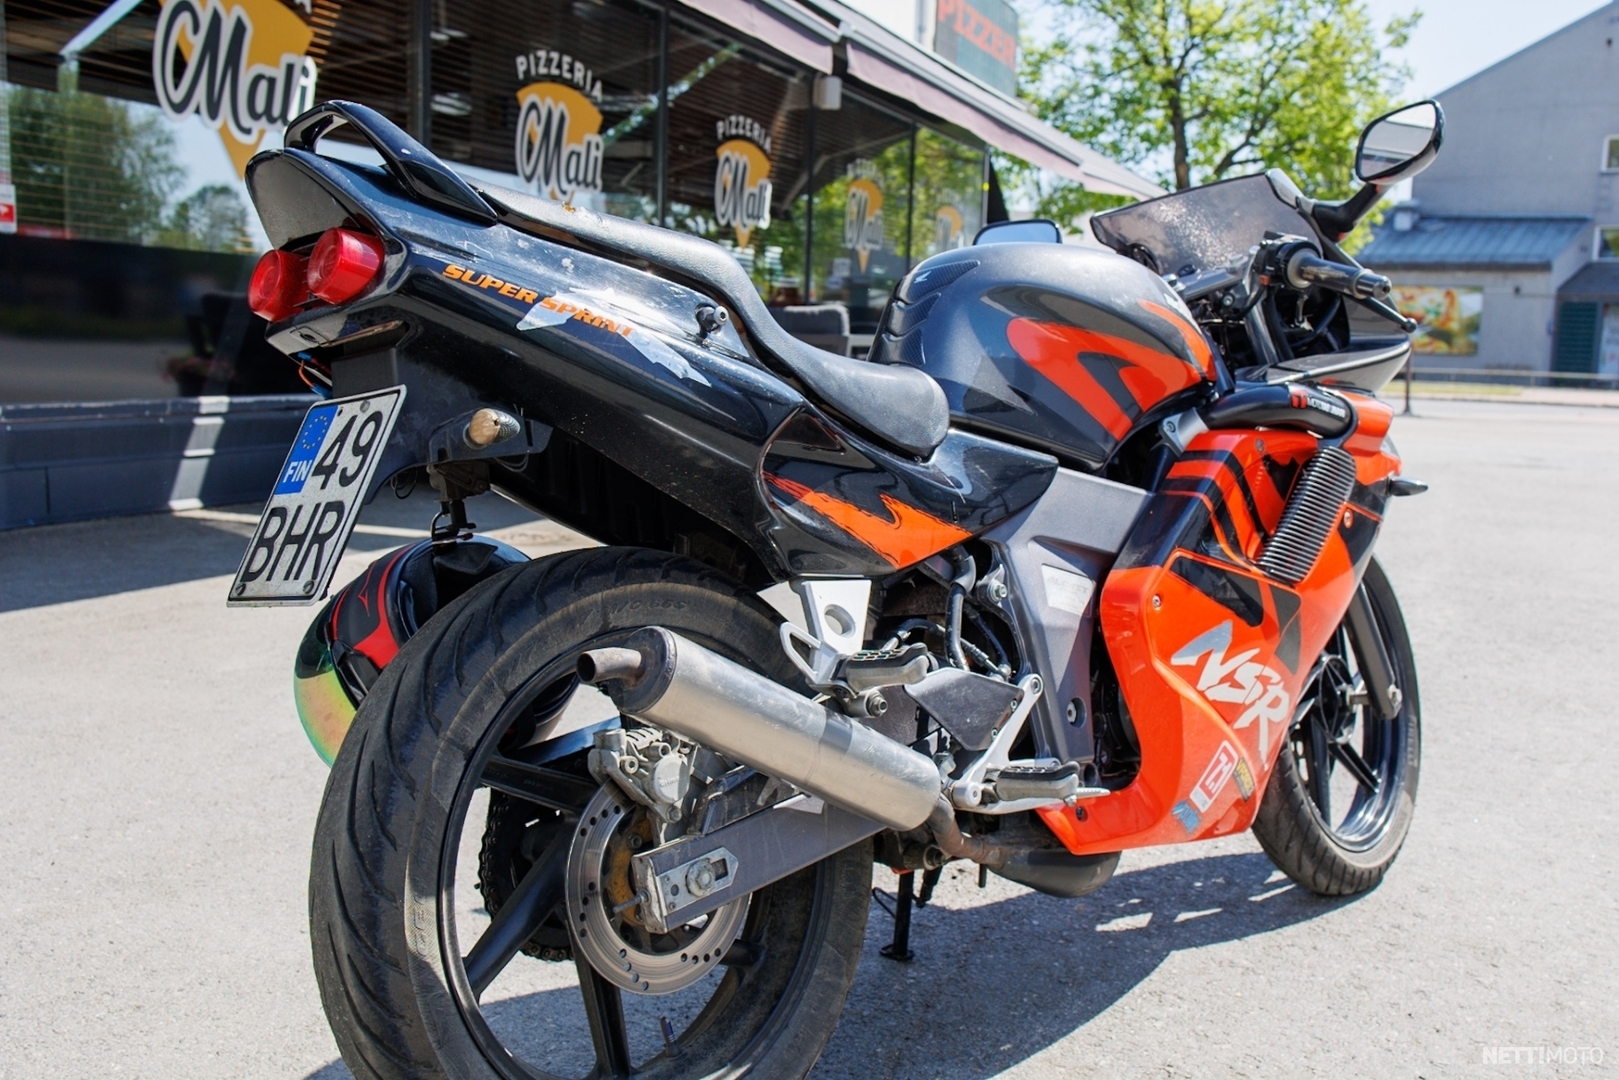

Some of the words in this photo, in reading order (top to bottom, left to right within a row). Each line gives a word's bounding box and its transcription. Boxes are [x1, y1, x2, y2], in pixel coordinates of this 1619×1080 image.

[154, 0, 317, 143] Mali
[516, 50, 603, 103] PIZZERIA
[516, 95, 603, 198] Mali
[716, 115, 771, 154] PIZZERIA
[715, 151, 771, 231] Mali
[442, 263, 538, 304] SUPER
[540, 295, 635, 338] SPRINT
[282, 459, 312, 483] FIN
[311, 410, 383, 490] 49
[240, 501, 346, 582] BHR
[1170, 619, 1290, 772] NSR
